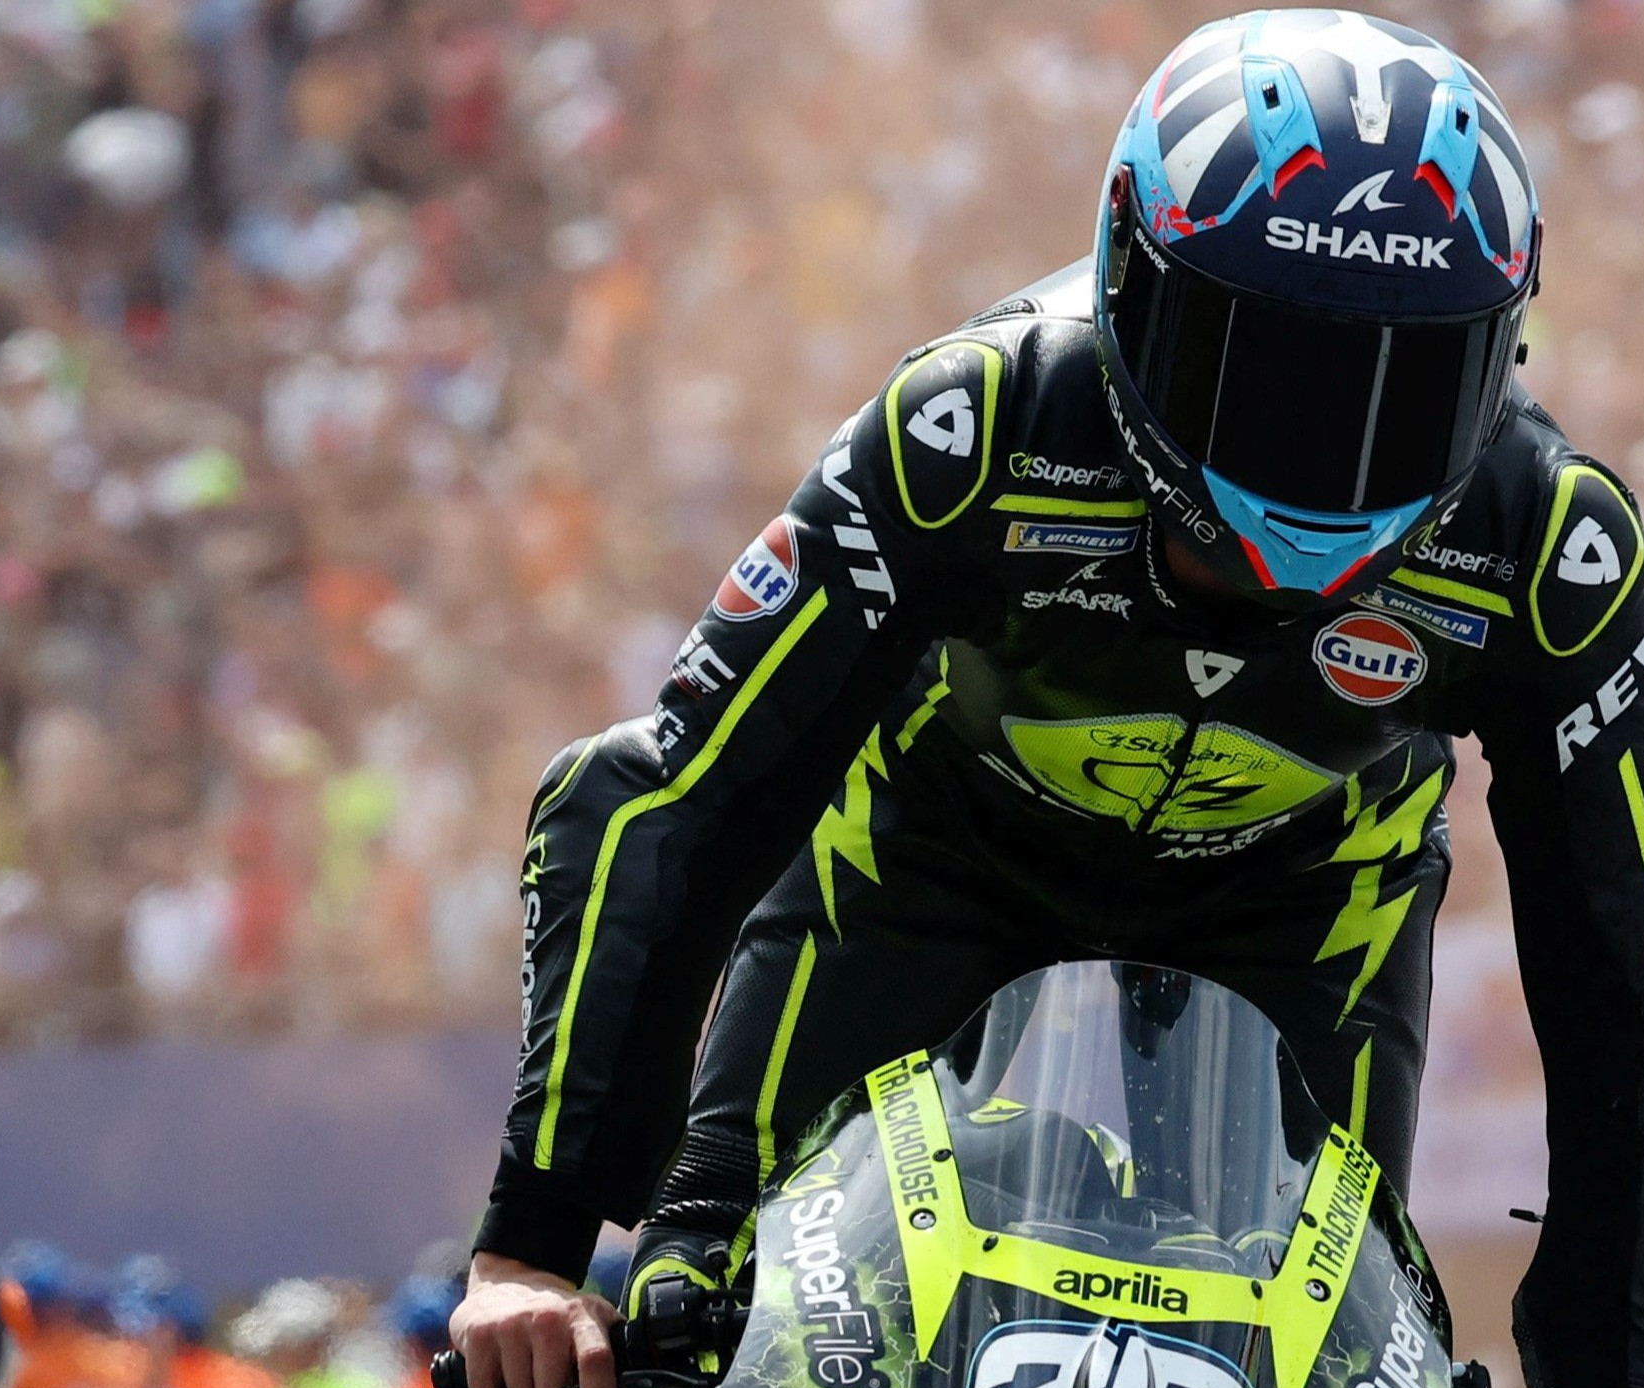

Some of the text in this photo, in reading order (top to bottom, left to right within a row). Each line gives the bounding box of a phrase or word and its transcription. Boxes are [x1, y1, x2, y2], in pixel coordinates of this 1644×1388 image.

[1265, 215, 1454, 270] SHARK
[1029, 456, 1129, 490] SuperFile
[1044, 533, 1129, 547] MICHELIN
[1415, 541, 1515, 582] SuperFile
[737, 556, 788, 602] ulf
[1021, 587, 1134, 622] SHARK
[1389, 595, 1475, 637] MICHELIN
[1320, 637, 1420, 679] Gulf
[876, 1058, 939, 1207] TRACKHOUSE
[1306, 1139, 1377, 1281] TRACKHOUSE
[781, 1185, 875, 1388] SuperFile
[1052, 1266, 1189, 1316] aprilia
